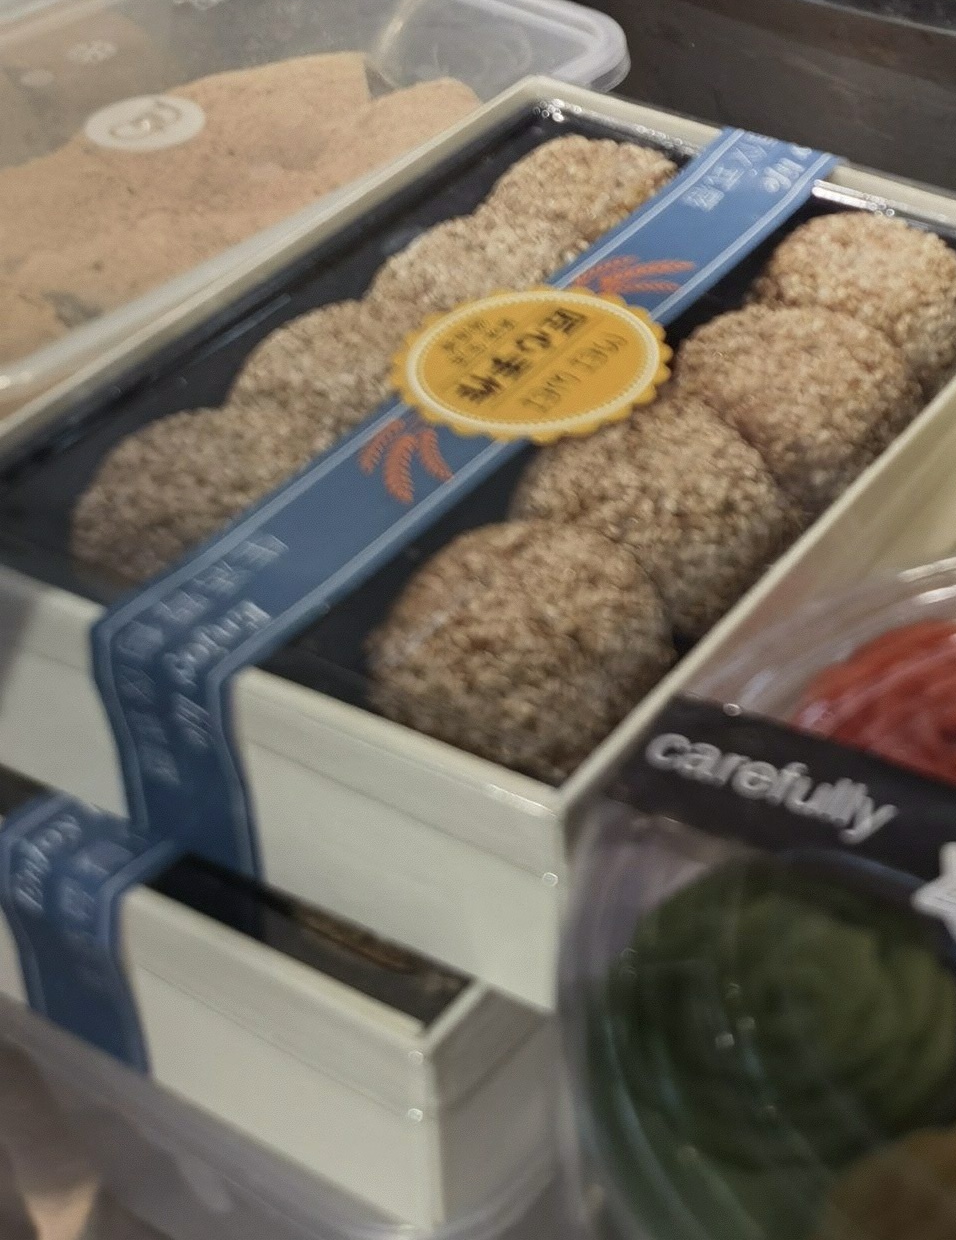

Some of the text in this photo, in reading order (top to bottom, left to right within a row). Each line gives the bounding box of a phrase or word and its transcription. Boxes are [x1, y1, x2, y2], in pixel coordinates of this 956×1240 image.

[456, 307, 589, 405] 匠心手作
[645, 733, 897, 844] carefully
